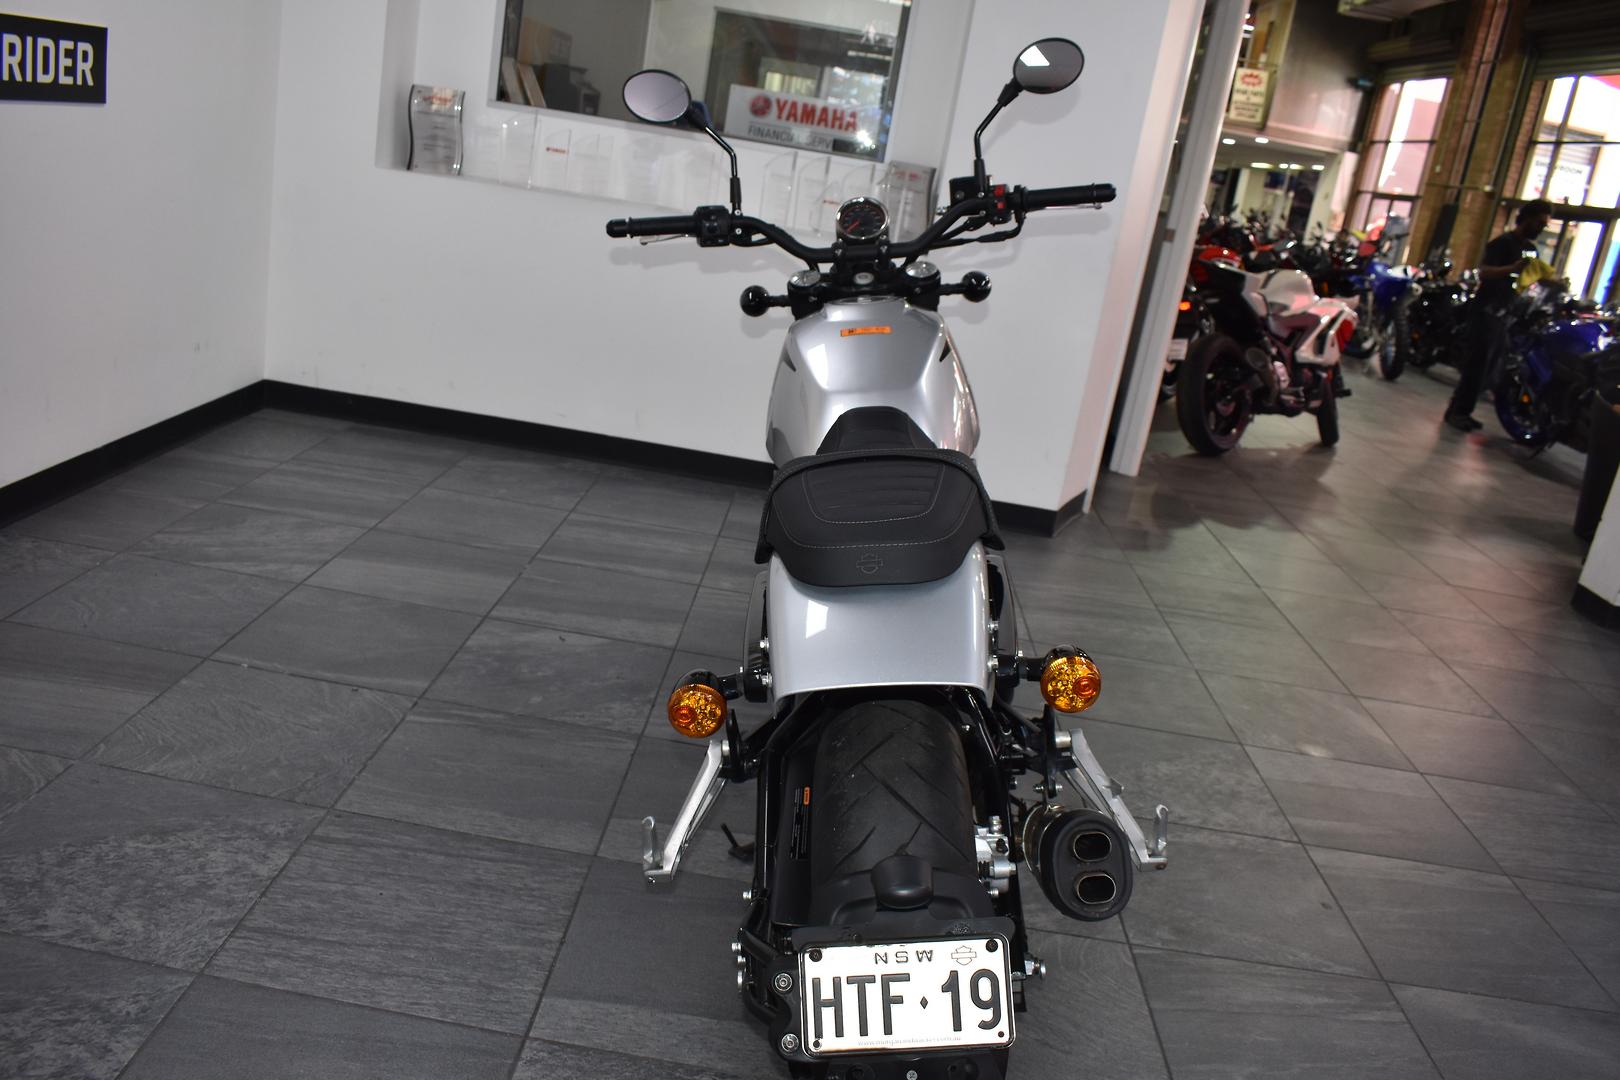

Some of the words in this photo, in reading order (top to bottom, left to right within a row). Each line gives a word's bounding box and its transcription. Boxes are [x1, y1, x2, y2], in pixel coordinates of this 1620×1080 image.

[2, 32, 94, 87] RIDER
[775, 96, 858, 132] YAMAHA
[748, 126, 801, 145] FINANCI
[874, 949, 934, 965] NSW
[811, 973, 911, 1039] HTF
[941, 968, 1002, 1032] 19
